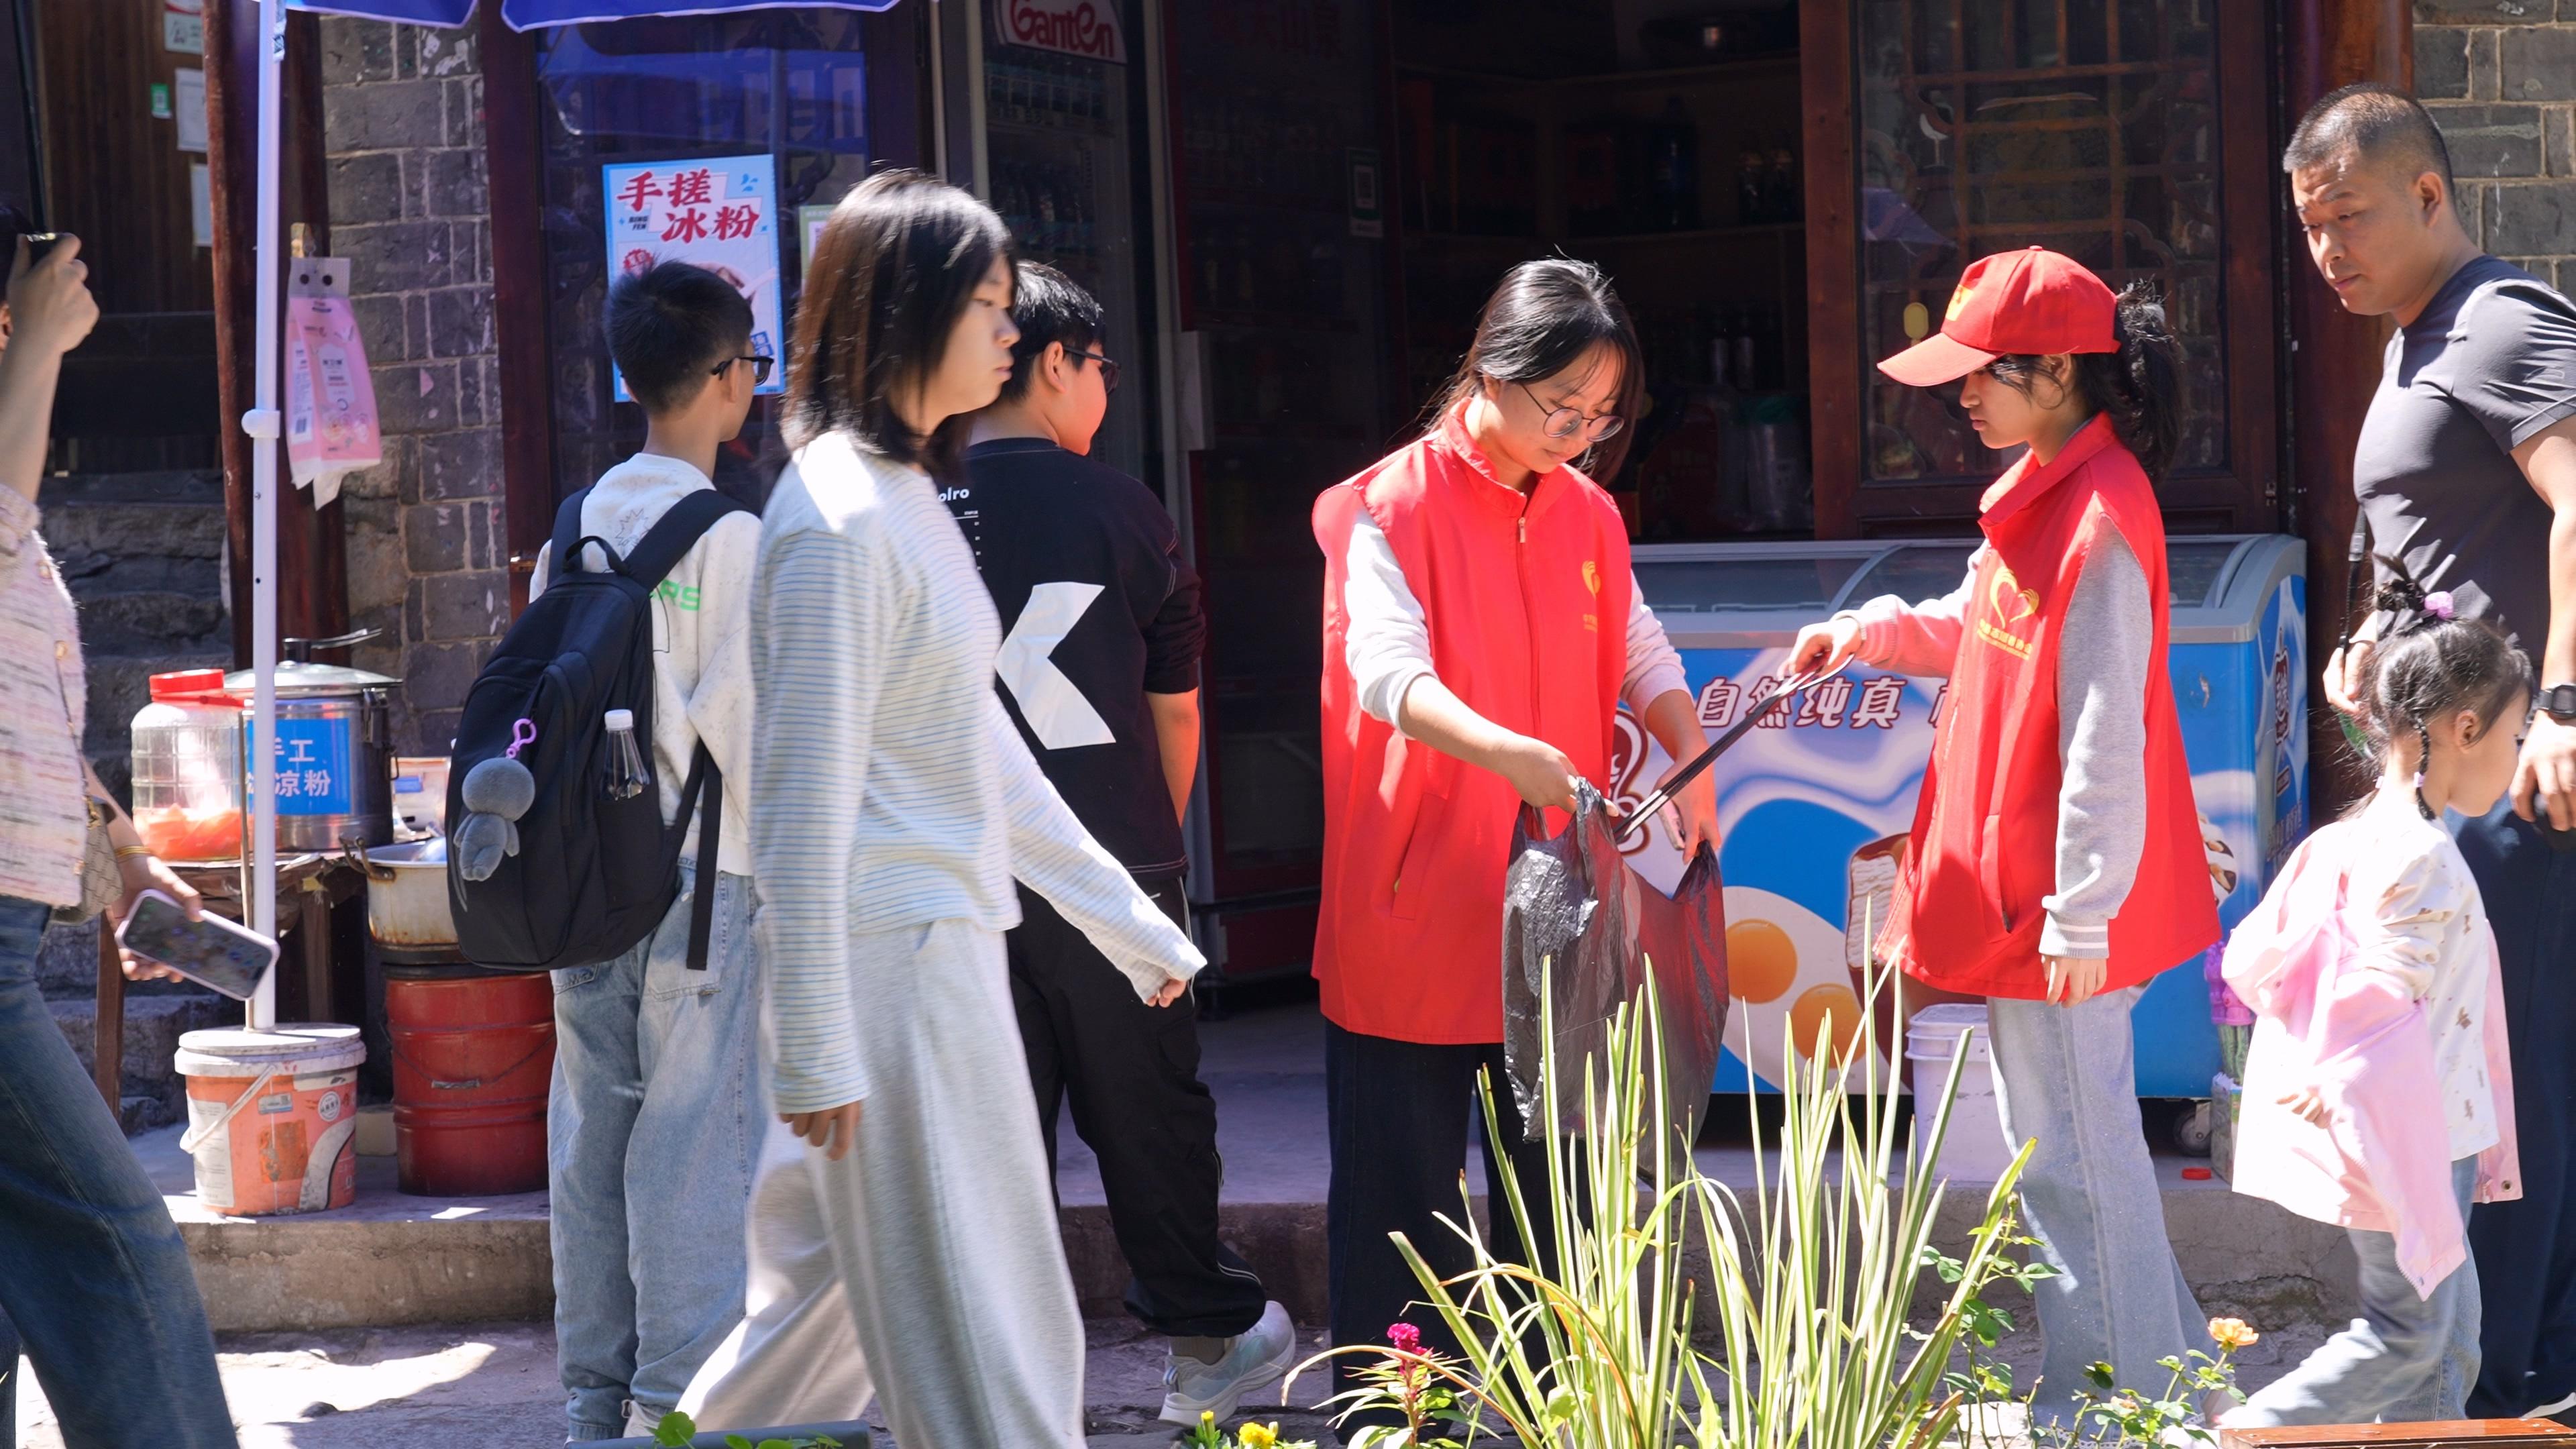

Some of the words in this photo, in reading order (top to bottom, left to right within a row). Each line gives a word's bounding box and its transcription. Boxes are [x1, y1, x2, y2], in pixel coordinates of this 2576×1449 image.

[616, 168, 712, 212] 手搓
[661, 204, 760, 244] 冰粉
[649, 578, 700, 611] RS
[1697, 676, 1908, 729] 自然纯真
